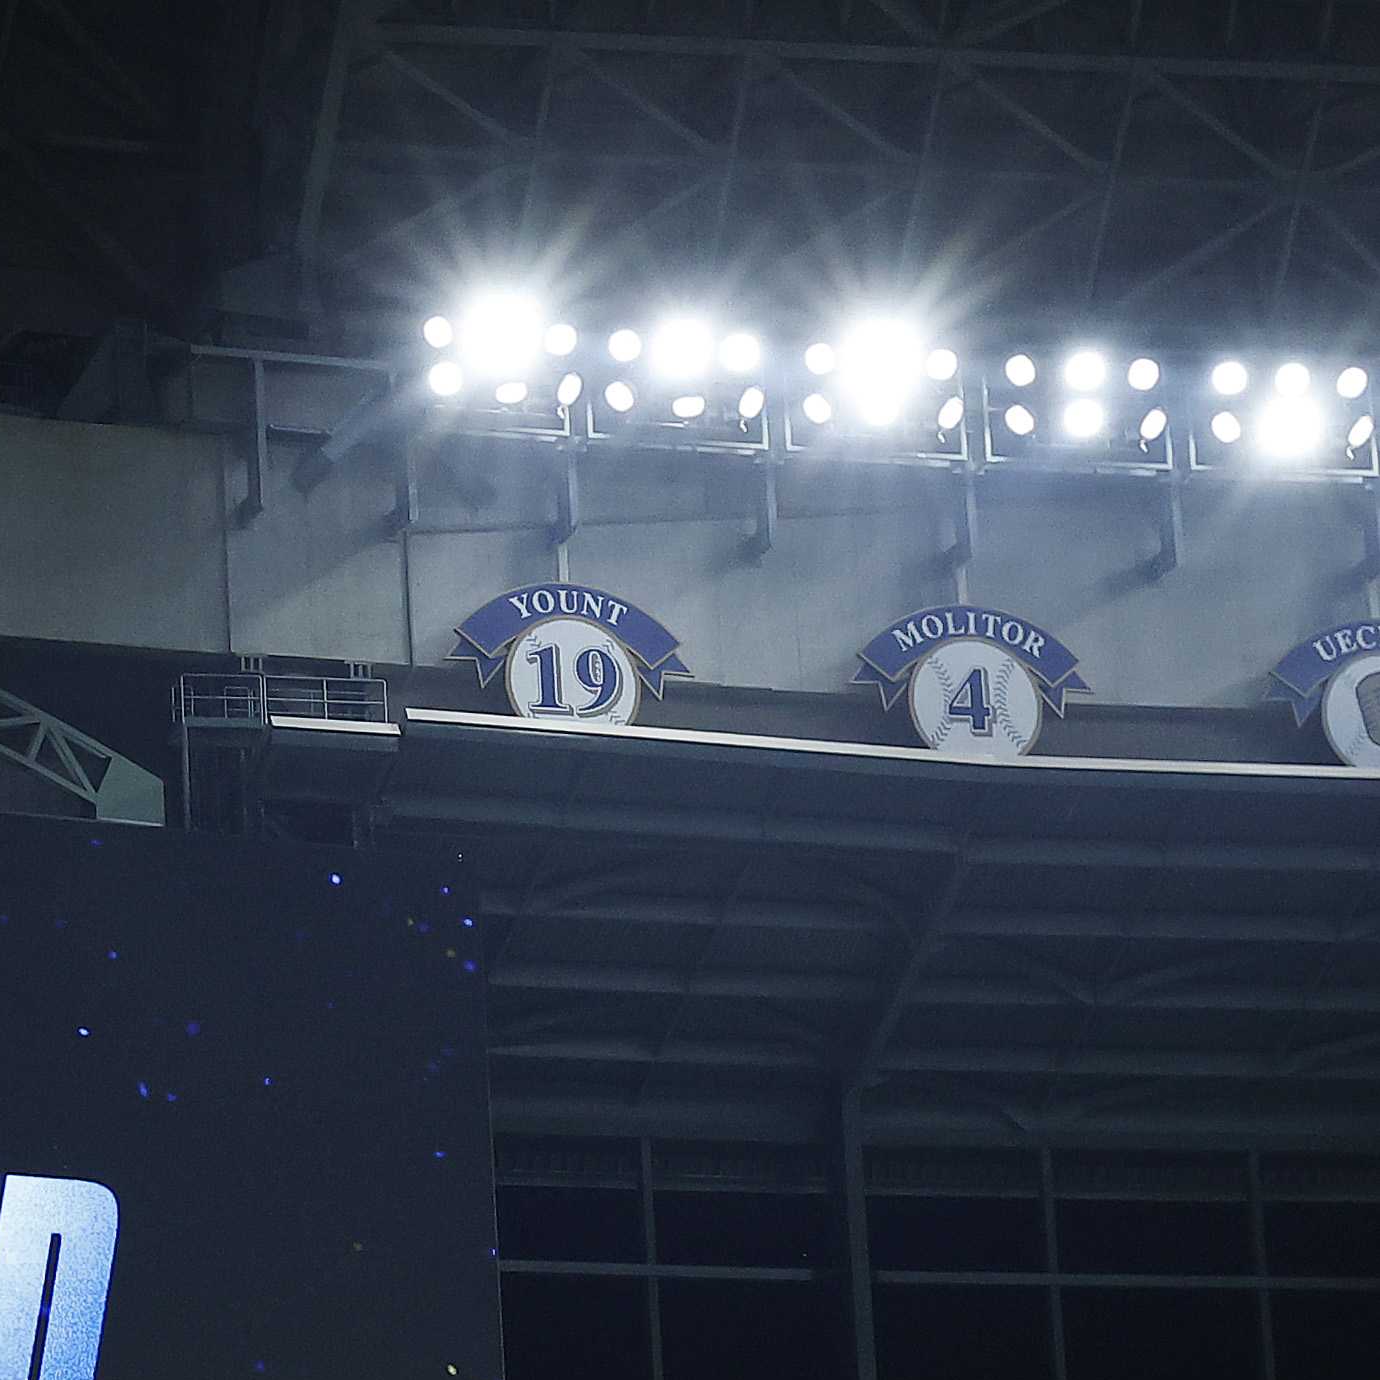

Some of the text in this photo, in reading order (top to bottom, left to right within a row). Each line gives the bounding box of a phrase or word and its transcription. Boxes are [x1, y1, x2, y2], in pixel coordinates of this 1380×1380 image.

[508, 589, 628, 626] YOUNT
[891, 611, 1046, 659] MOLITOR
[1313, 625, 1380, 661] UEC
[526, 643, 626, 717] 19
[948, 666, 996, 737] 4
